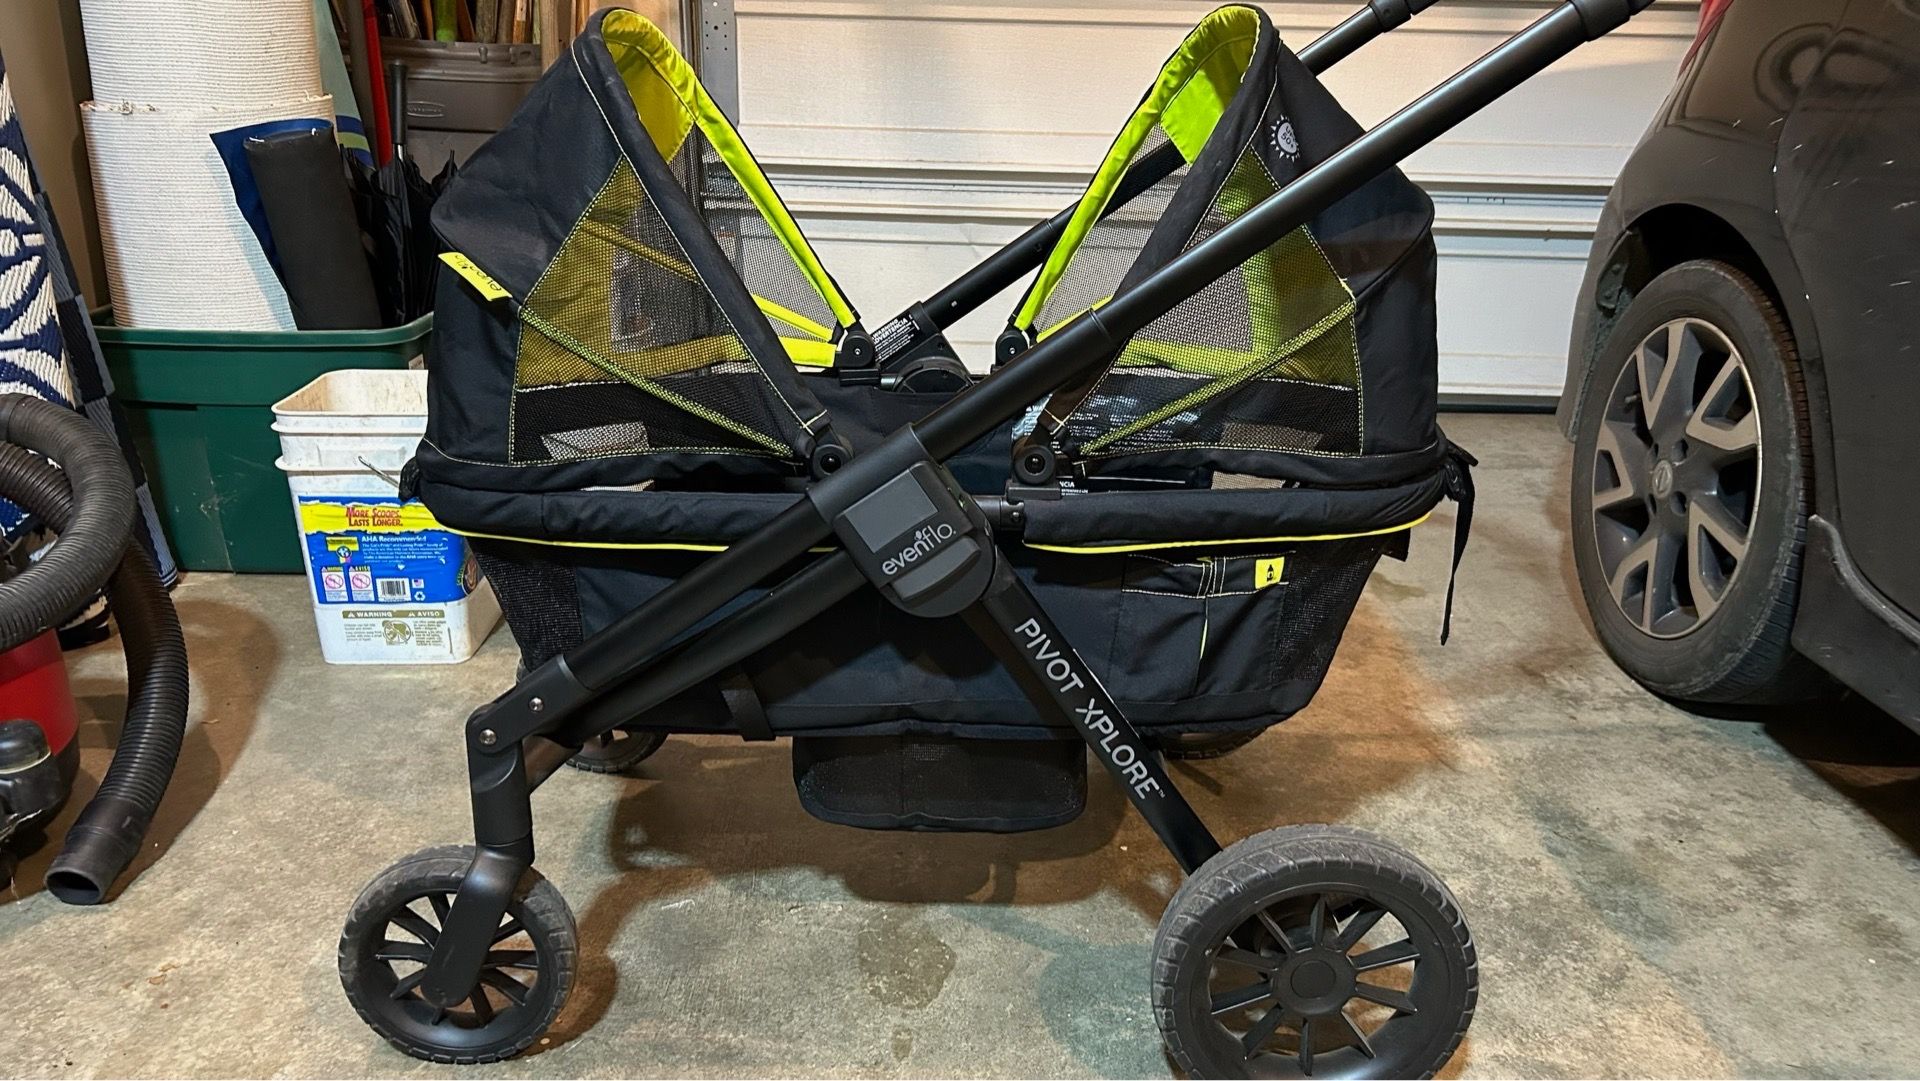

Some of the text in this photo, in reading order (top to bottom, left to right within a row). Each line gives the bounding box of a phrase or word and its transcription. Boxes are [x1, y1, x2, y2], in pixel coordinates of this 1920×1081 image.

[346, 507, 369, 518] MORE
[349, 516, 370, 527] LASTS
[361, 535, 378, 543] AHA
[1014, 618, 1084, 693] PIVOT
